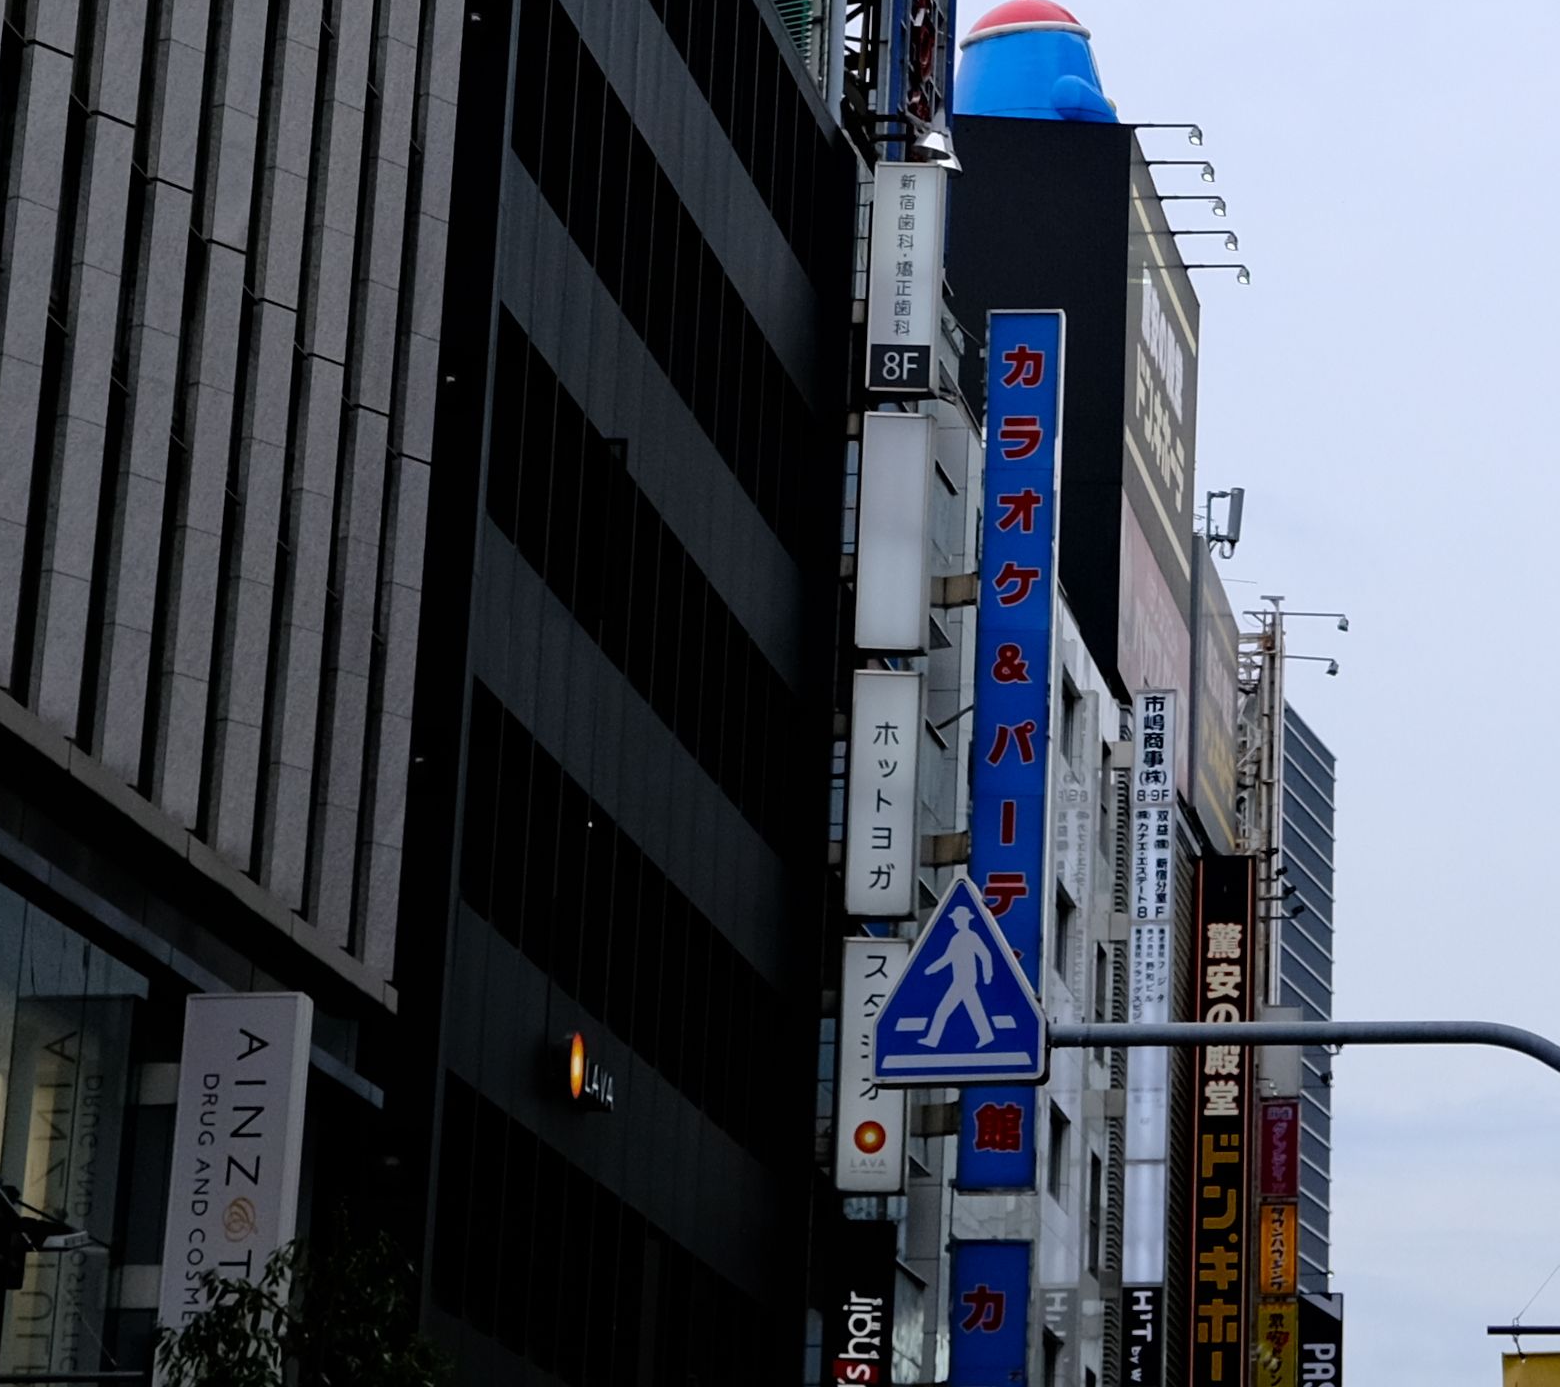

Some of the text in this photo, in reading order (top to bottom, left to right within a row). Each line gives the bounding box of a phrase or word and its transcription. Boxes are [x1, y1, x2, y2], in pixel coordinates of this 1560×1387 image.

[892, 173, 918, 337] 新宿歯科・矯正歯科
[881, 351, 920, 381] 8F
[867, 721, 901, 891] ホットヨガ
[225, 1028, 270, 1186] AINZ
[849, 1157, 887, 1169] LAVA
[181, 1073, 220, 1323] DRUG AND COSME
[837, 1290, 875, 1360] hair
